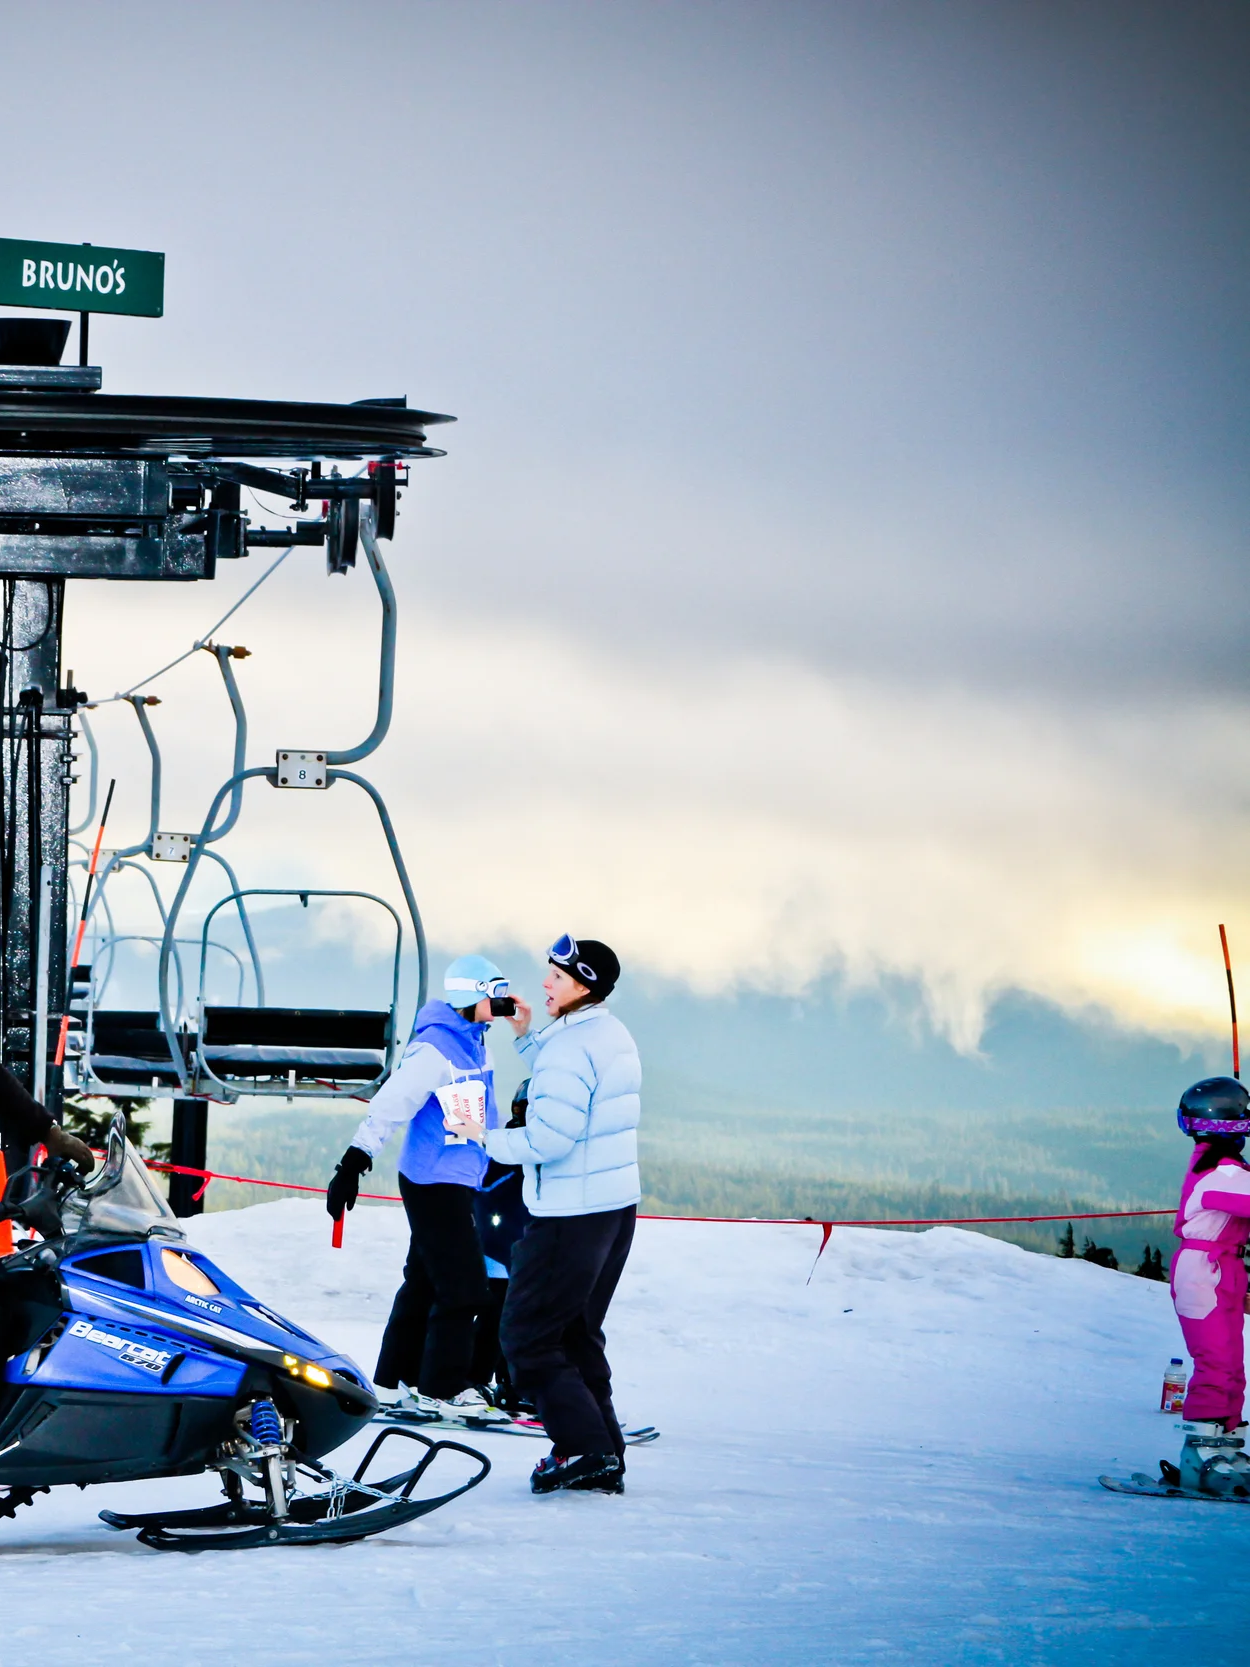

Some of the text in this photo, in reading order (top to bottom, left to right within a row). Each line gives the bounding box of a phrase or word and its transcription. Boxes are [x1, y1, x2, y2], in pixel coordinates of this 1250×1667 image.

[22, 258, 126, 295] BRUNO'S
[298, 770, 307, 780] 8
[169, 847, 175, 855] 7
[185, 1295, 222, 1314] ARCTIC CAT
[68, 1320, 171, 1366] Bearcat
